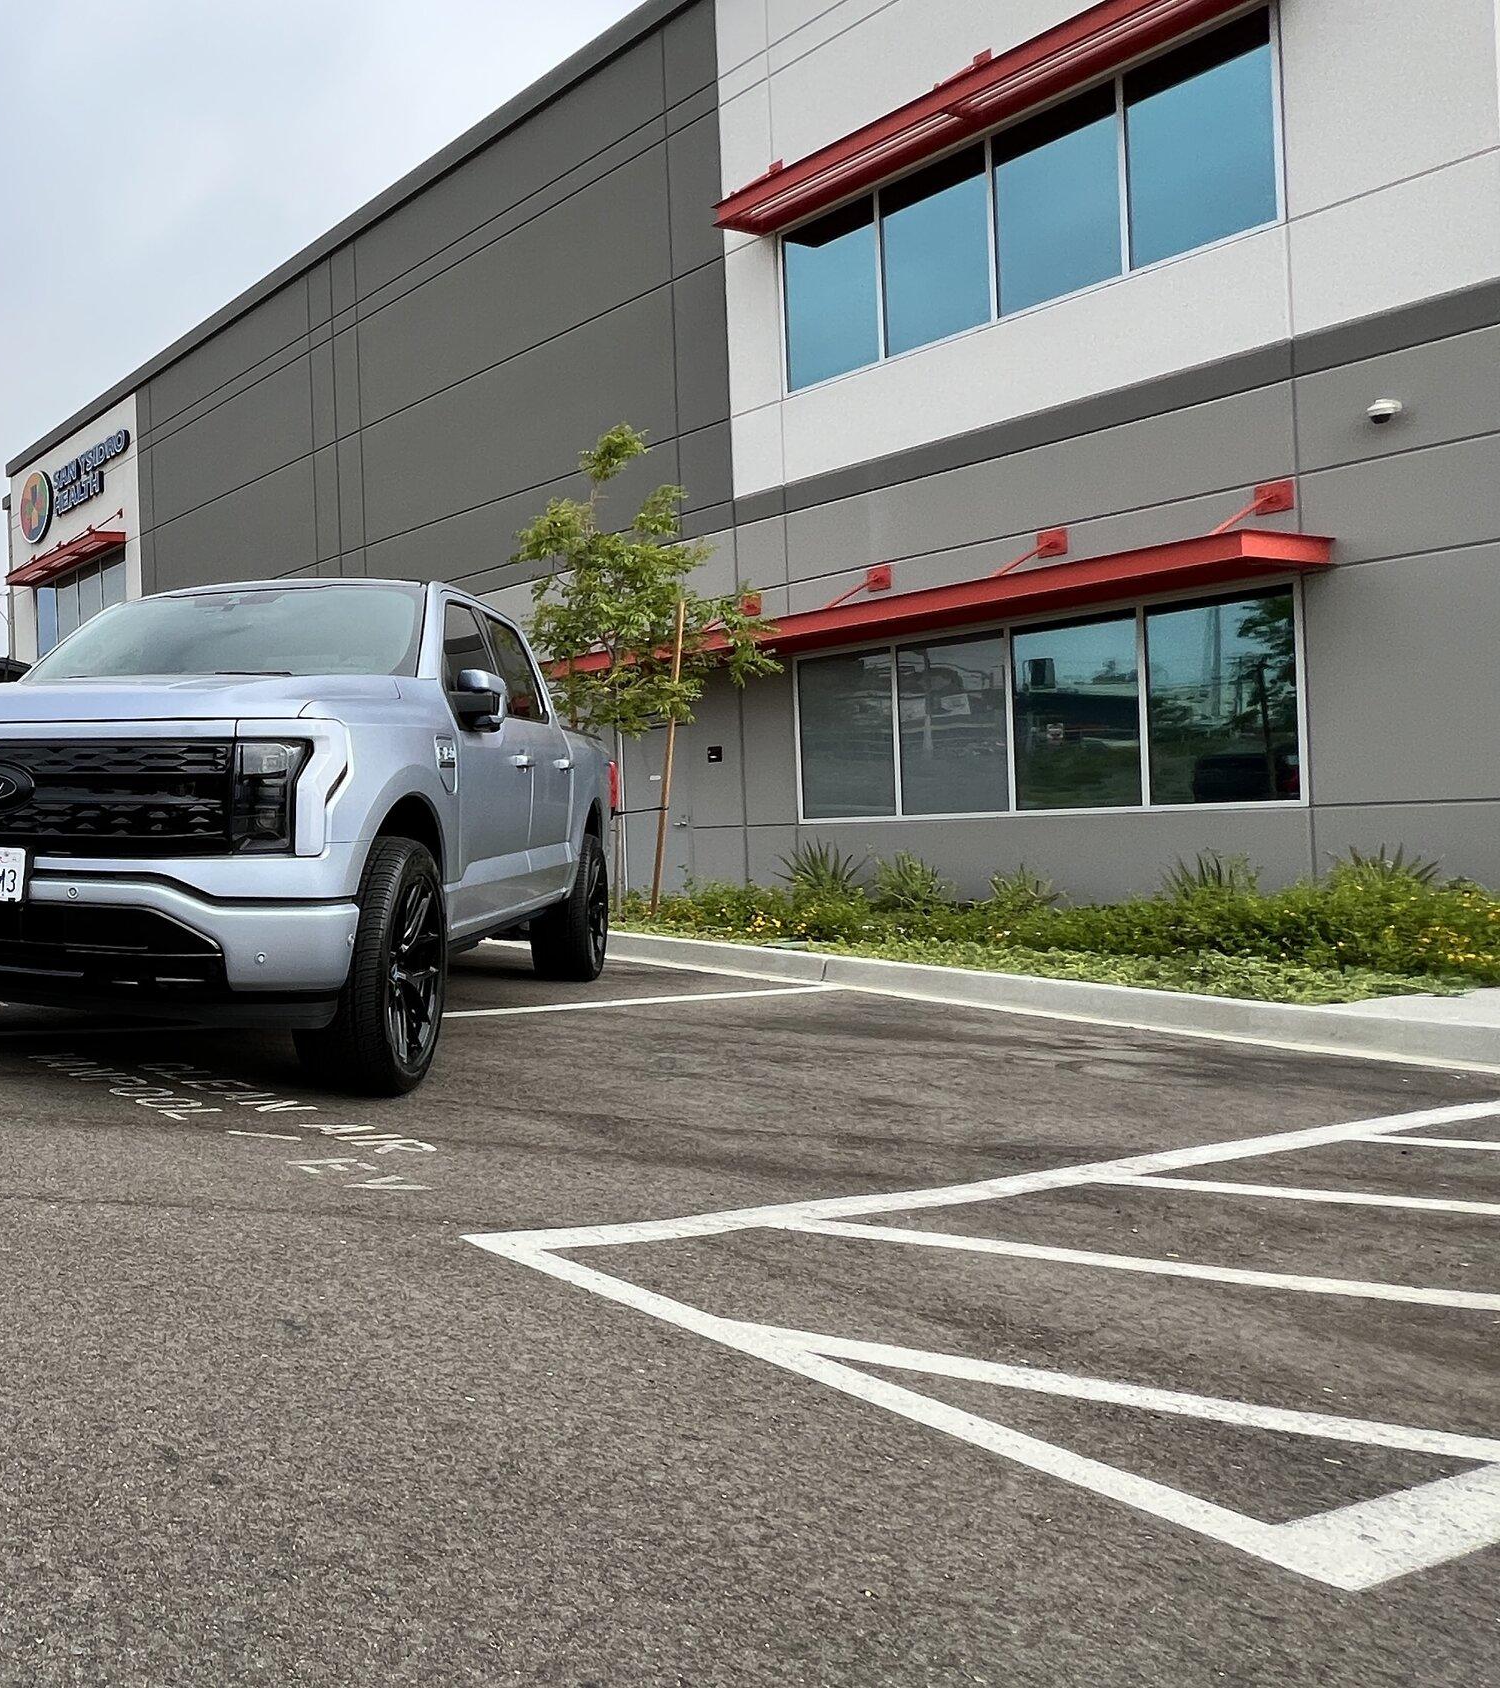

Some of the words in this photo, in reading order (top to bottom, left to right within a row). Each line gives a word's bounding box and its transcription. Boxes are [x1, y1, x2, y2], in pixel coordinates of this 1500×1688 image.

[53, 459, 81, 491] SAN
[78, 429, 130, 475] YSIDRO
[54, 470, 104, 517] HEALTH
[27, 1053, 223, 1121] VANPOOL
[285, 1157, 432, 1190] EV
[138, 1062, 318, 1113] CLEAN
[298, 1123, 438, 1154] AIR
